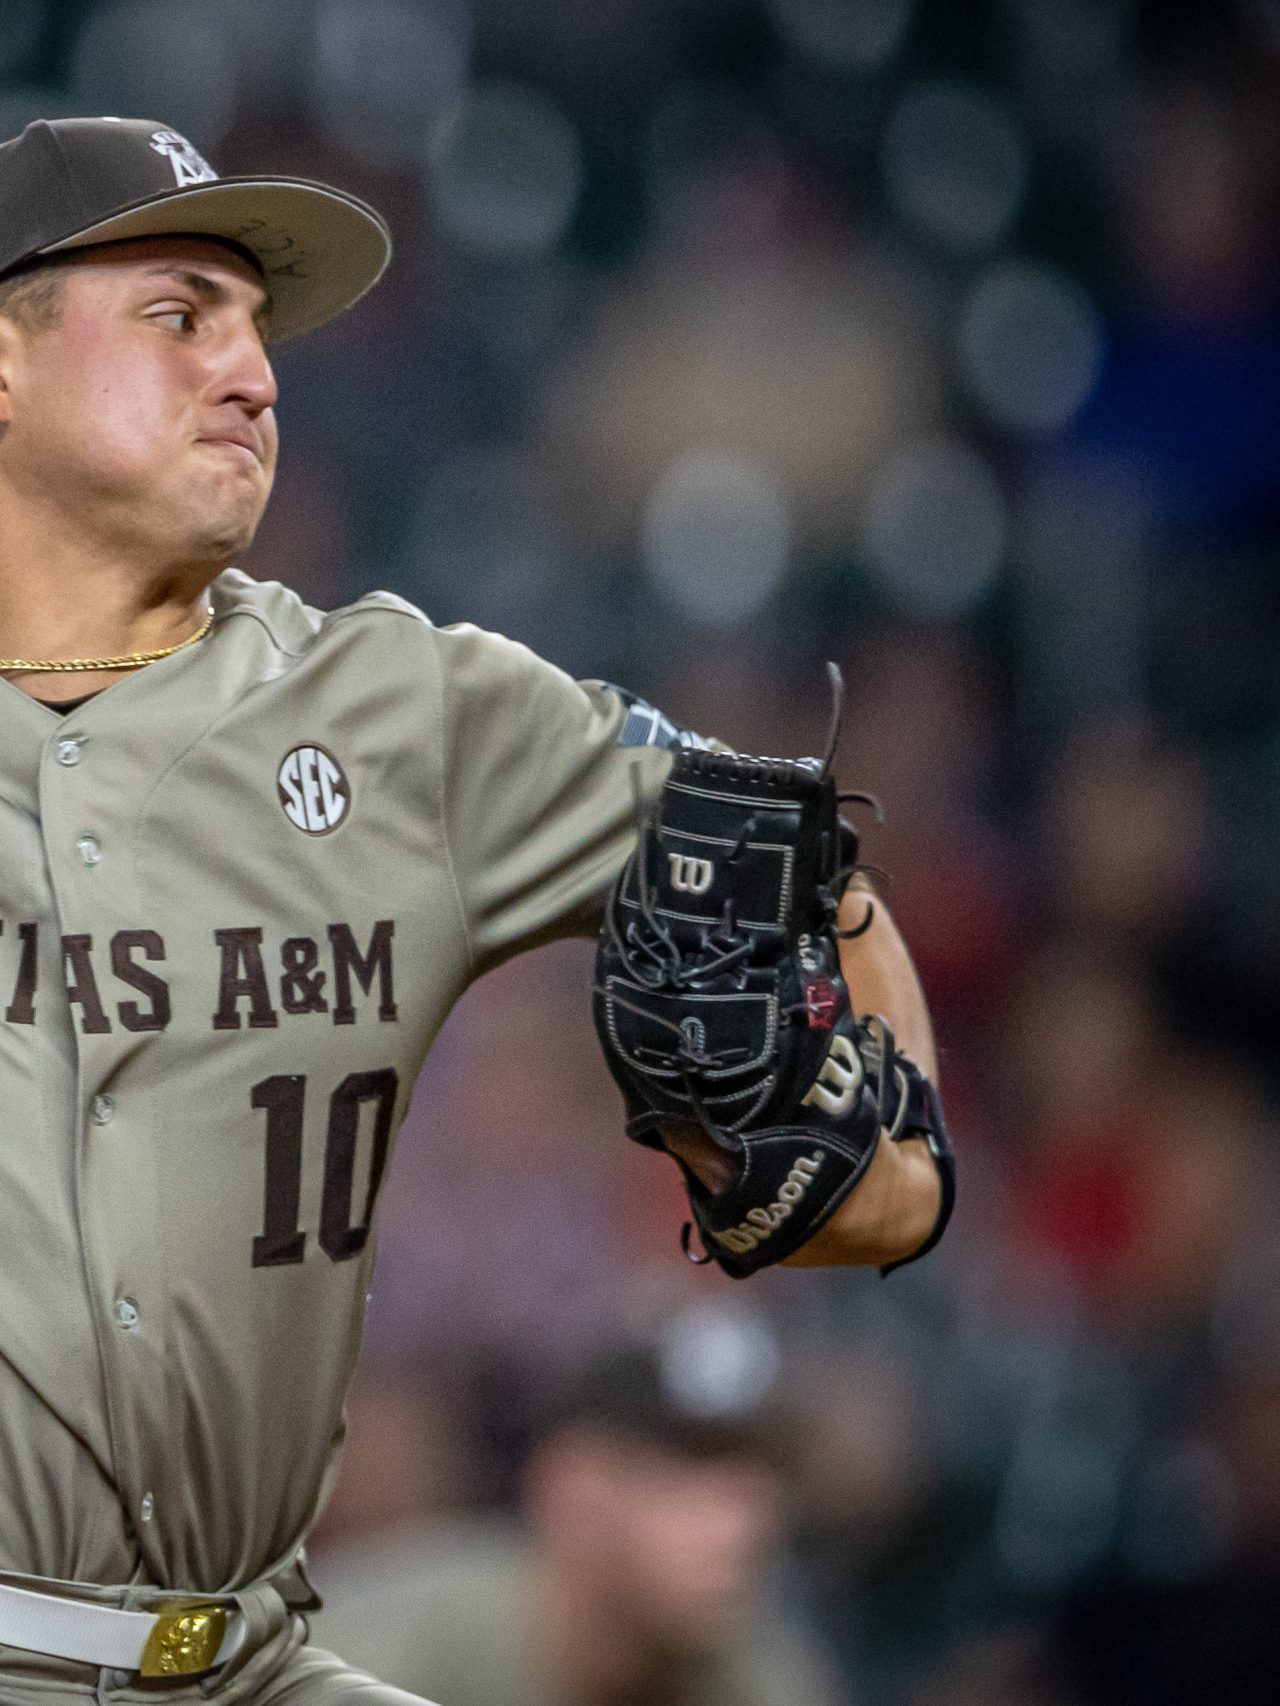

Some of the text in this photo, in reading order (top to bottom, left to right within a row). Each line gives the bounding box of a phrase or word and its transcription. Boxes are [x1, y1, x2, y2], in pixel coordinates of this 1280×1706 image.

[278, 747, 346, 832] SEC
[668, 852, 714, 896] W
[211, 919, 398, 1031] A&M
[800, 1034, 865, 1115] W
[249, 1067, 401, 1270] 10
[711, 1152, 824, 1254] Wilson
